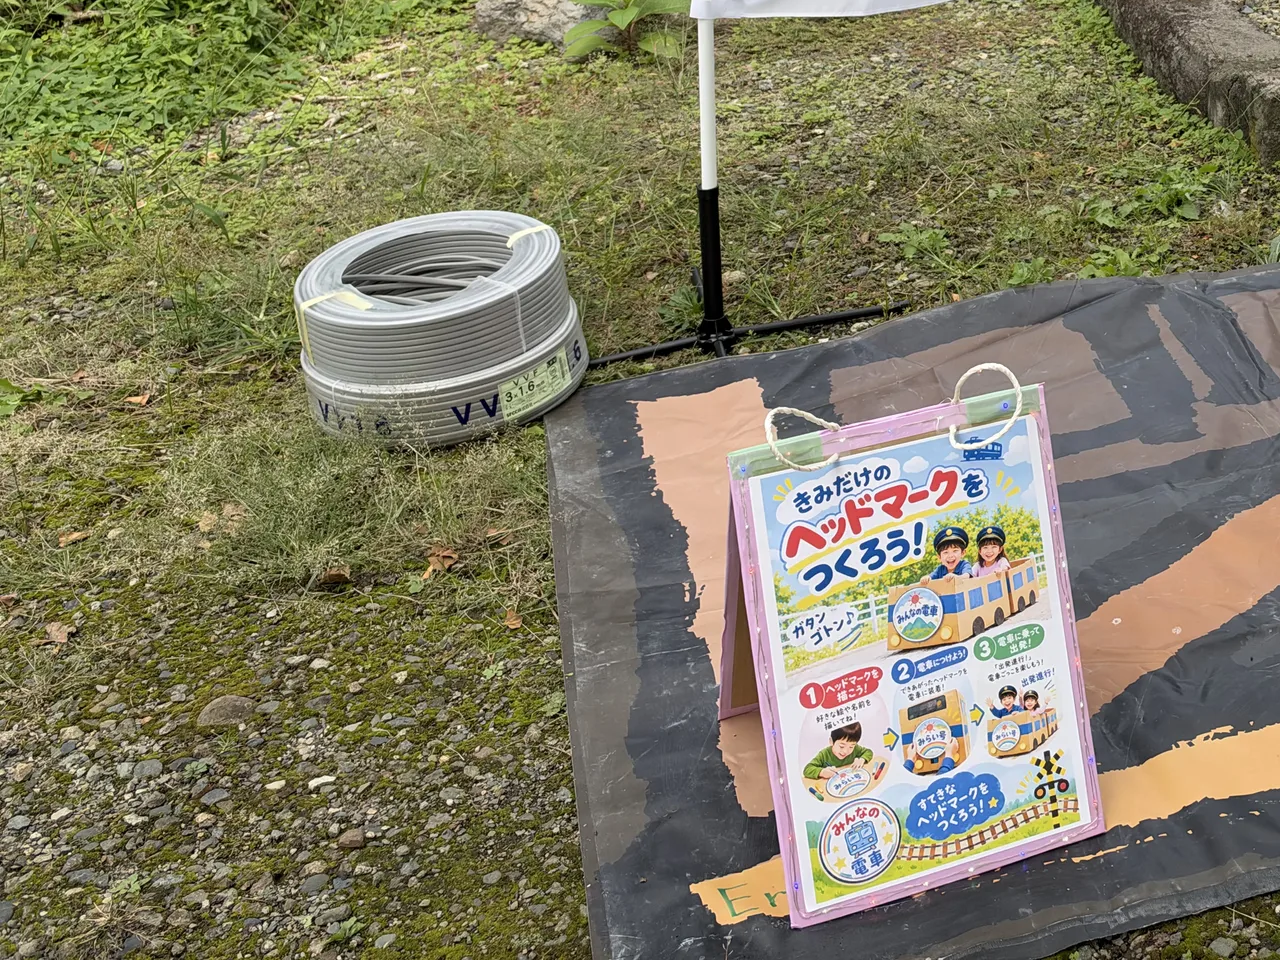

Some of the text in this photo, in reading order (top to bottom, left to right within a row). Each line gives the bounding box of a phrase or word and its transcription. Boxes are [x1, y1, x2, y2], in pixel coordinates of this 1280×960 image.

[793, 465, 891, 513] きみだけの
[785, 470, 983, 559] ヘッドマークを
[803, 522, 923, 591] つくろう！
[896, 604, 938, 624] みんなの電車
[792, 612, 826, 639] ガタン
[997, 627, 1040, 646] 電車に乗って
[1009, 639, 1032, 654] 出発！
[979, 640, 990, 657] 3
[916, 649, 967, 673] 電車につけよう！
[987, 659, 1044, 682] 電車ごっこを楽しもう！
[994, 654, 1032, 670] 「出発進行！」
[825, 670, 879, 694] ヘッドマークを
[897, 664, 909, 681] 2
[900, 668, 968, 694] できあがったヘッドマークを
[1021, 668, 1055, 687] 出発進行！
[806, 687, 817, 705] 1
[836, 684, 868, 703] 描こう！
[907, 684, 945, 702] 電車に装着！
[816, 698, 872, 723] 好きな絵や名前を
[824, 714, 857, 731] 描いてね！
[917, 731, 947, 747] みらい号
[995, 729, 1017, 741] みらい号
[833, 773, 862, 791] みらい号
[917, 783, 956, 810] すてきな
[917, 782, 989, 828] ヘッドマークを
[831, 806, 880, 836] みんなの
[937, 802, 984, 832] つくろう！
[851, 851, 885, 877] 電車
